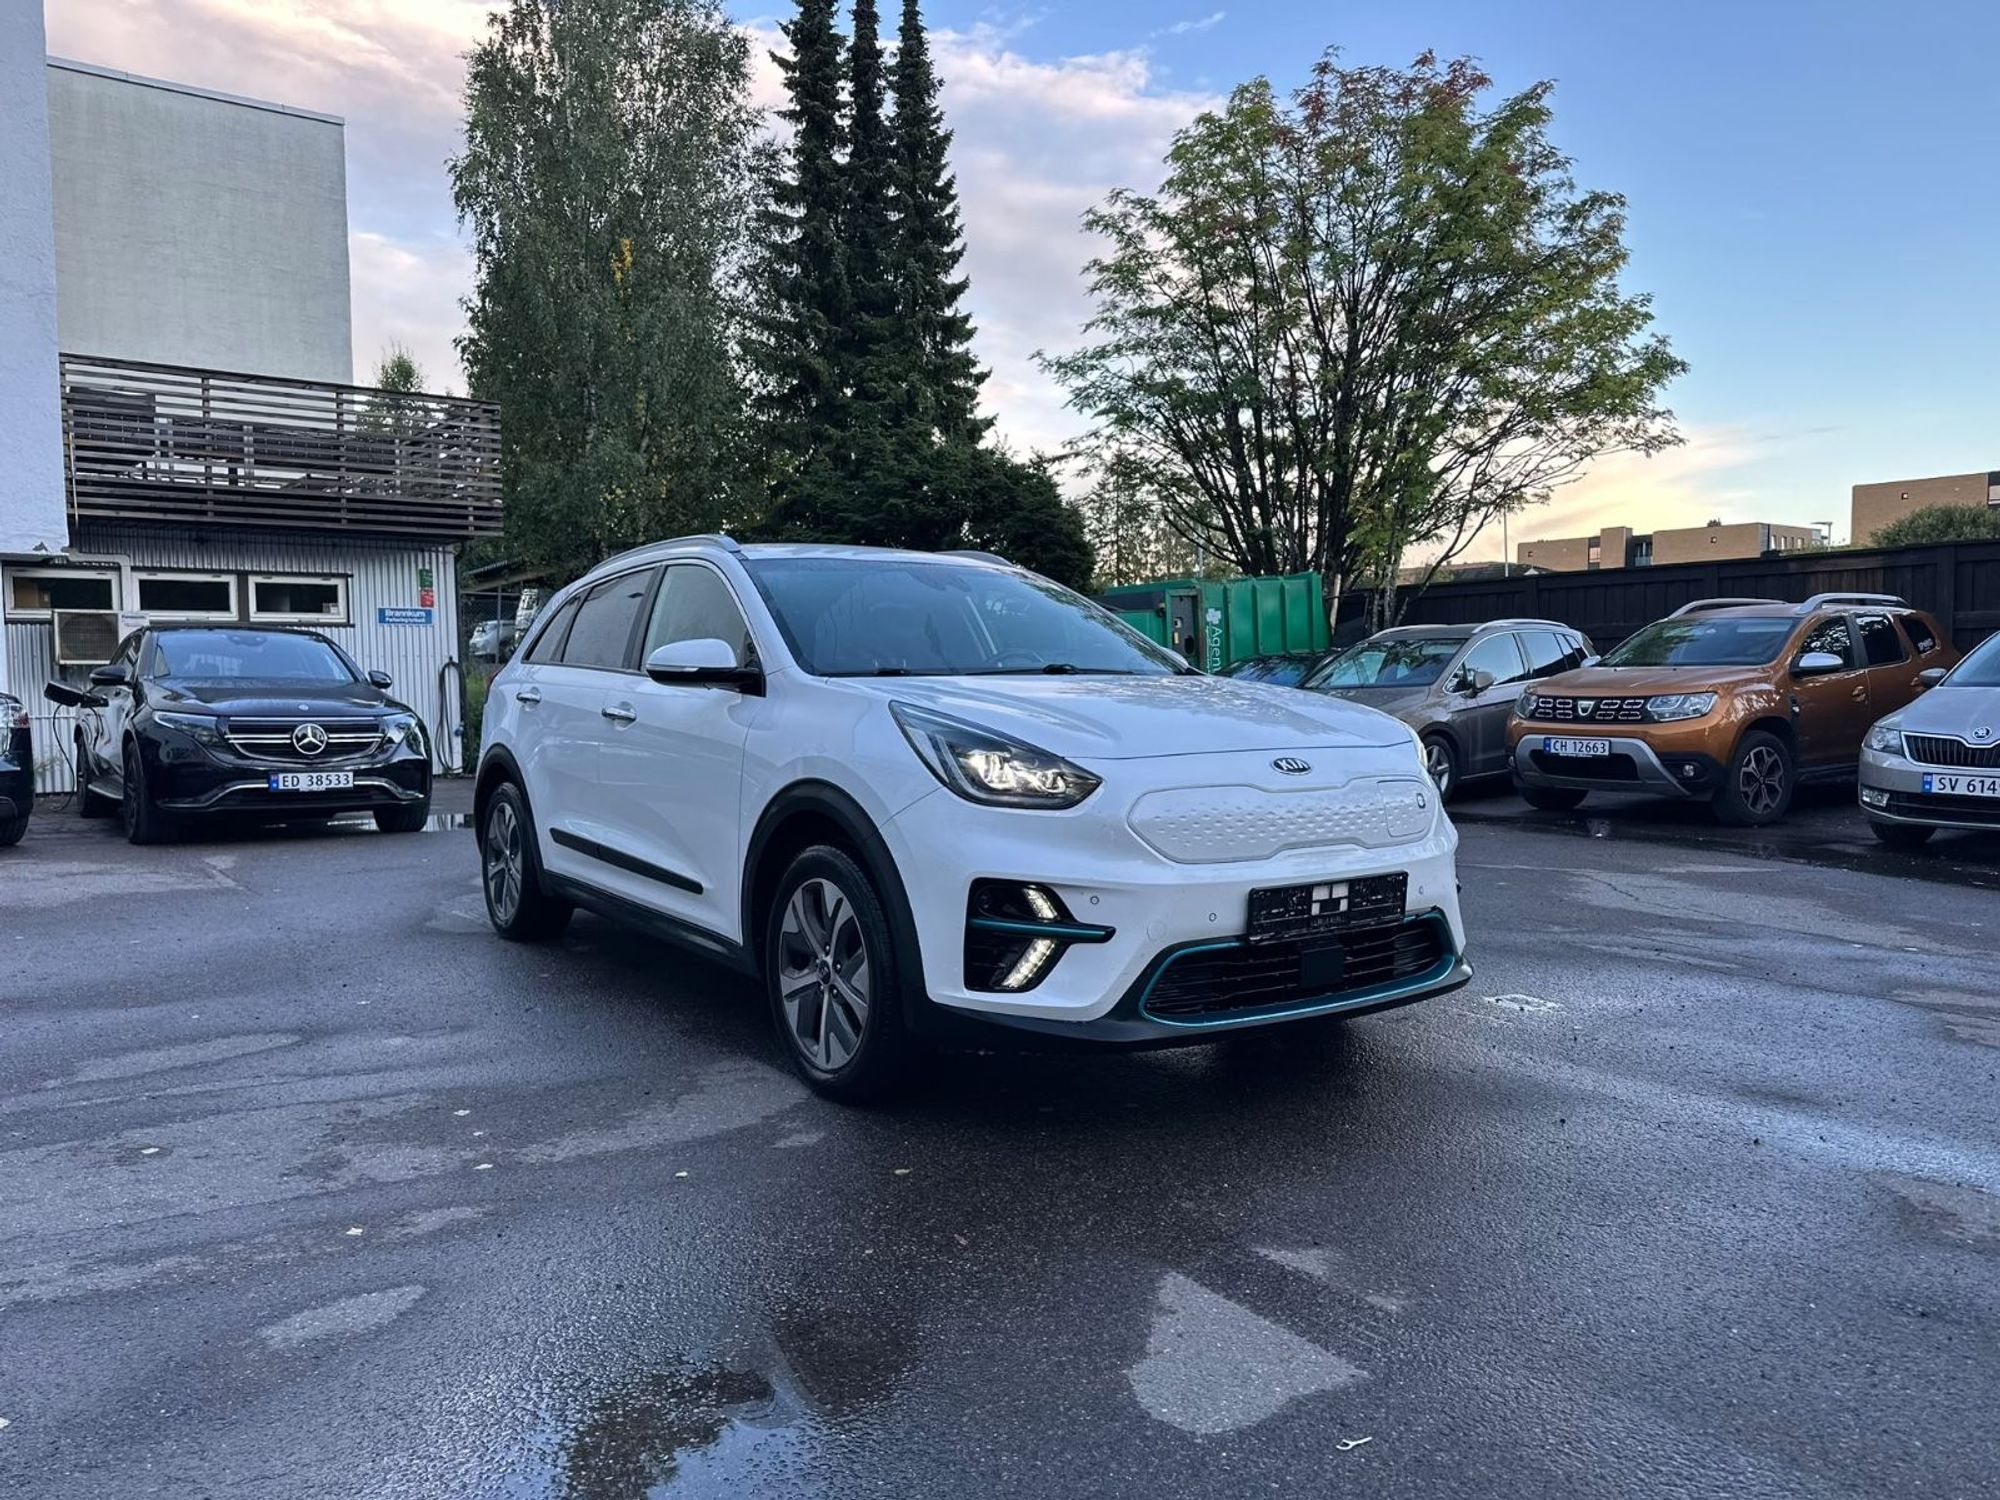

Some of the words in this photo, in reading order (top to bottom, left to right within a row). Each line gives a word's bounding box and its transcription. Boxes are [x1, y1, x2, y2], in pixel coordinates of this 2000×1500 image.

[1553, 740, 1568, 752] CH
[1573, 741, 1606, 754] 12663
[1276, 758, 1309, 769] KIA
[282, 775, 300, 787] ED
[307, 774, 350, 787] 38533
[1938, 777, 1959, 792] SV
[1966, 778, 2000, 795] 614
